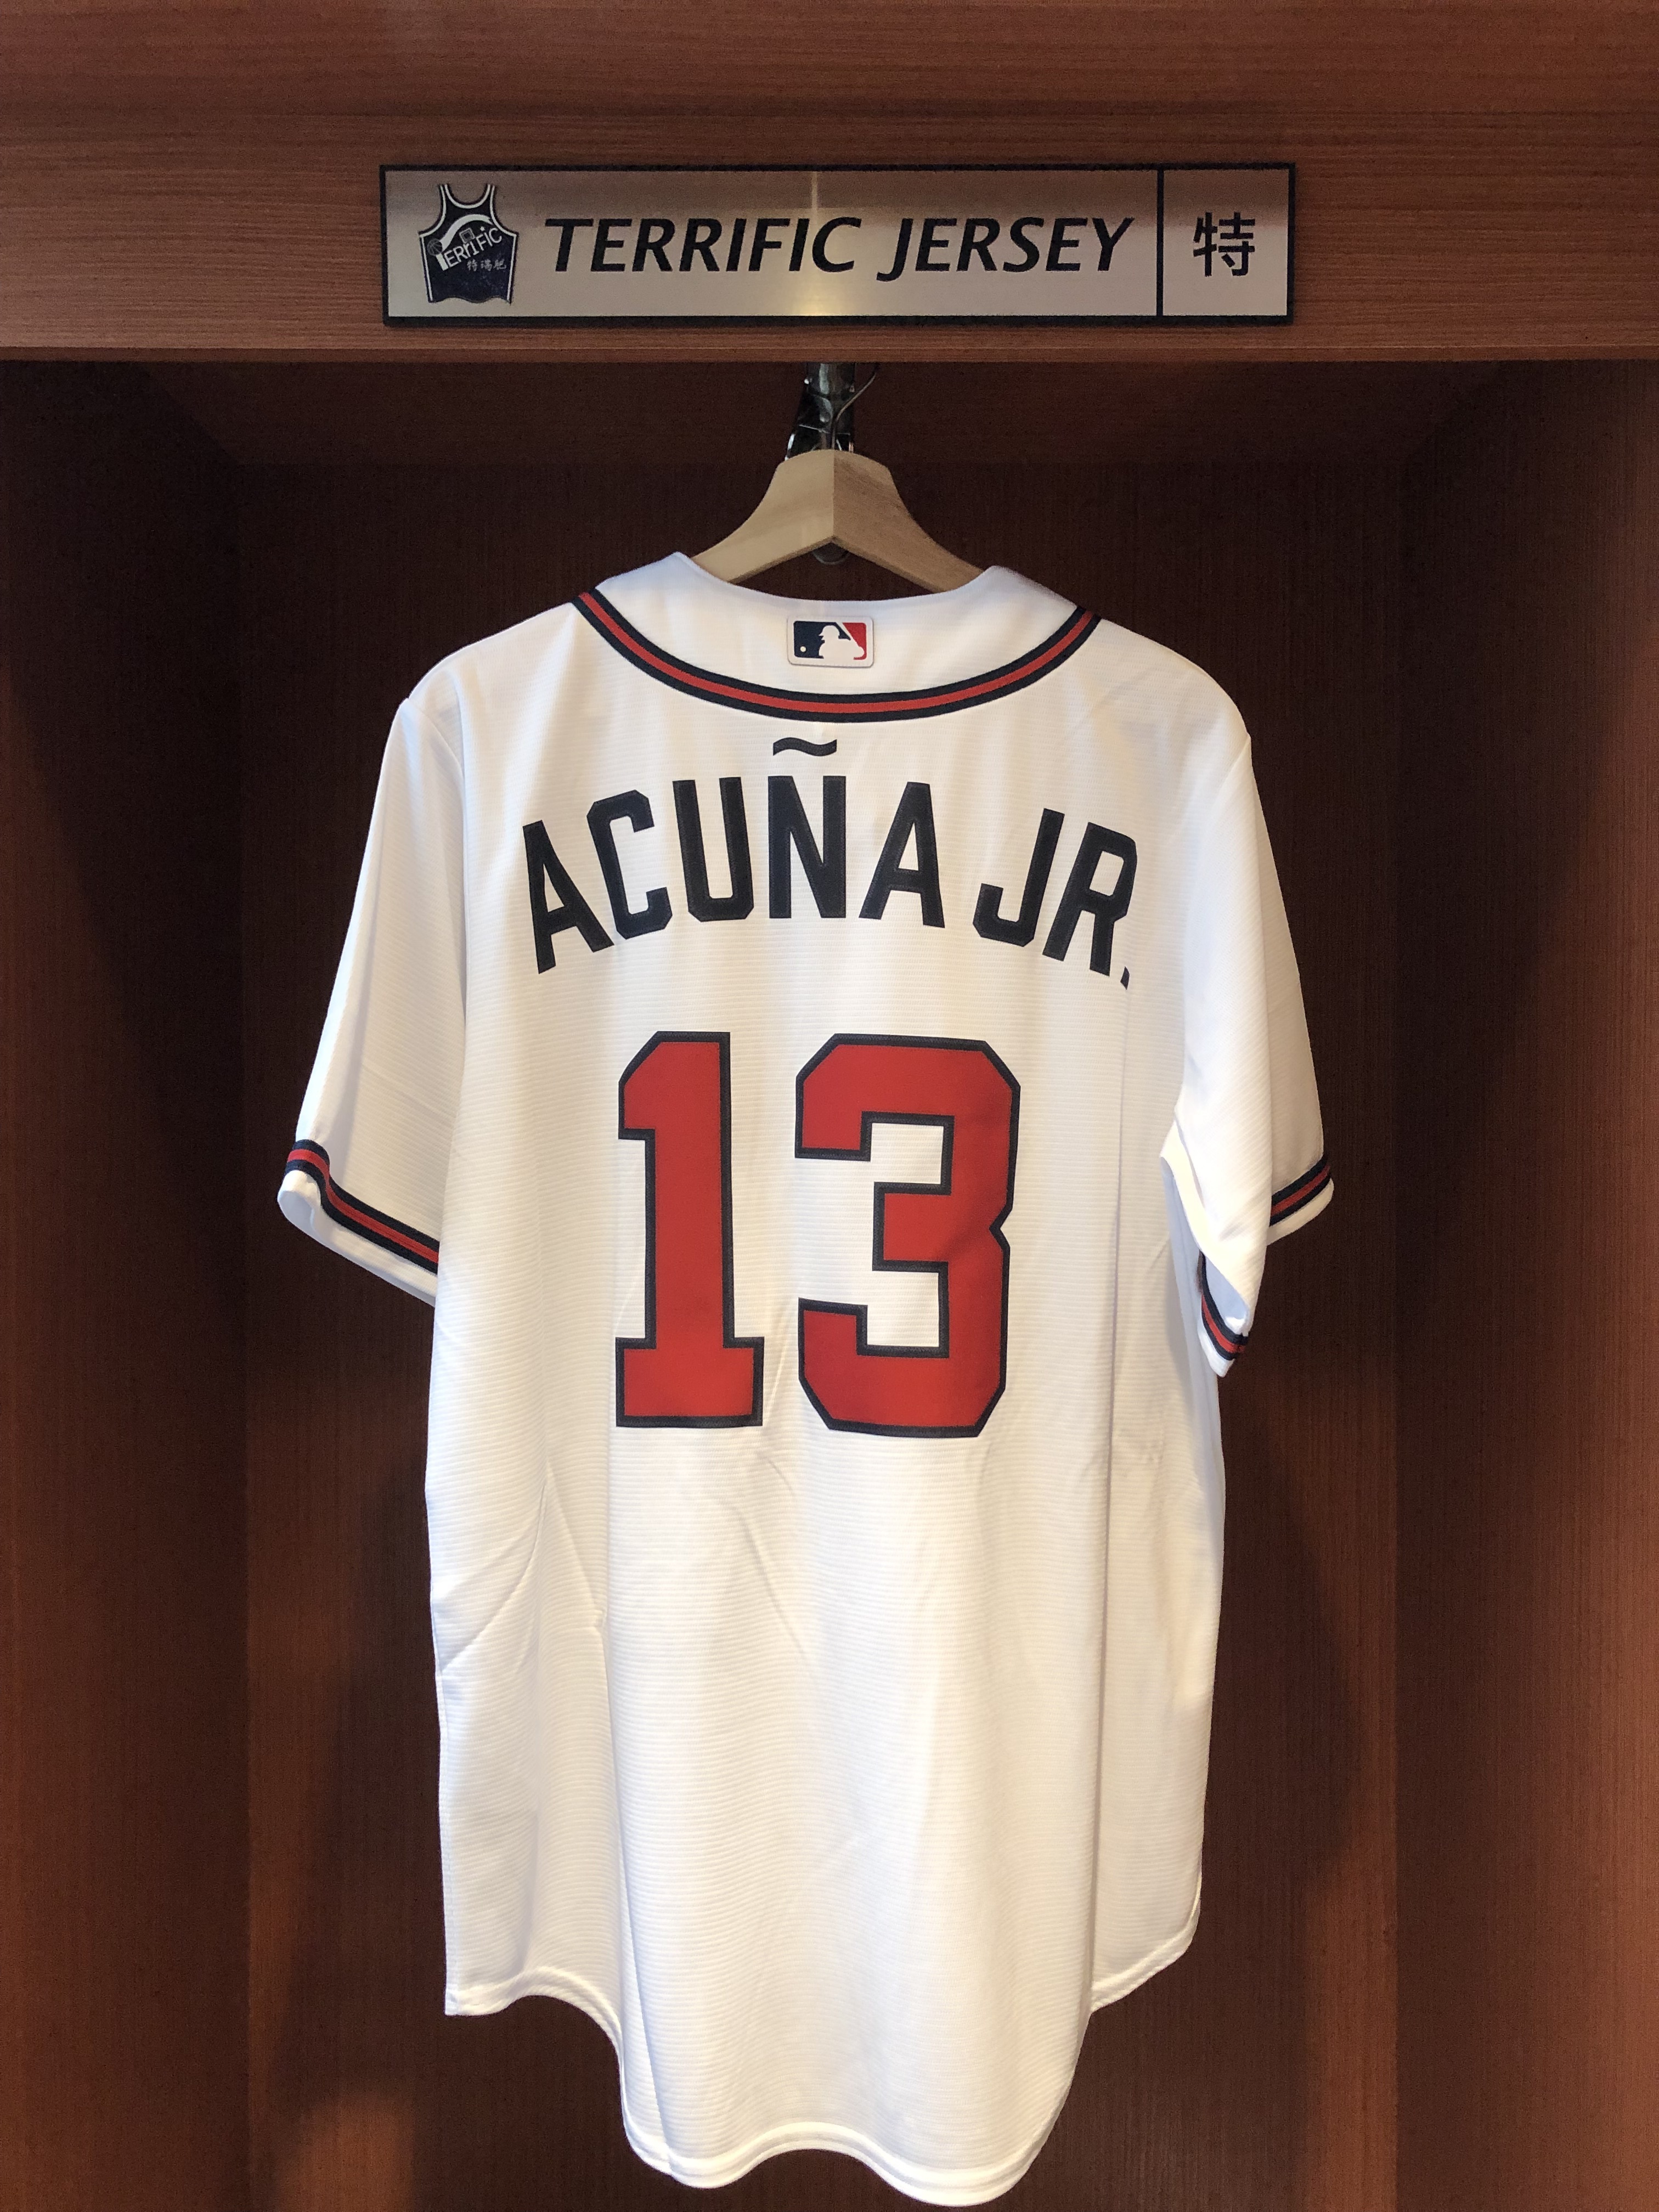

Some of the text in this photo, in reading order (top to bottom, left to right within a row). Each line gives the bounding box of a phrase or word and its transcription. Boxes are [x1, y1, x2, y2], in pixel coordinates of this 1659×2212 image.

[544, 216, 1136, 282] TERRIFIC JERSEY
[1192, 212, 1256, 277] 特
[522, 737, 945, 974] ACUÑA
[616, 1031, 1021, 1438] 13
